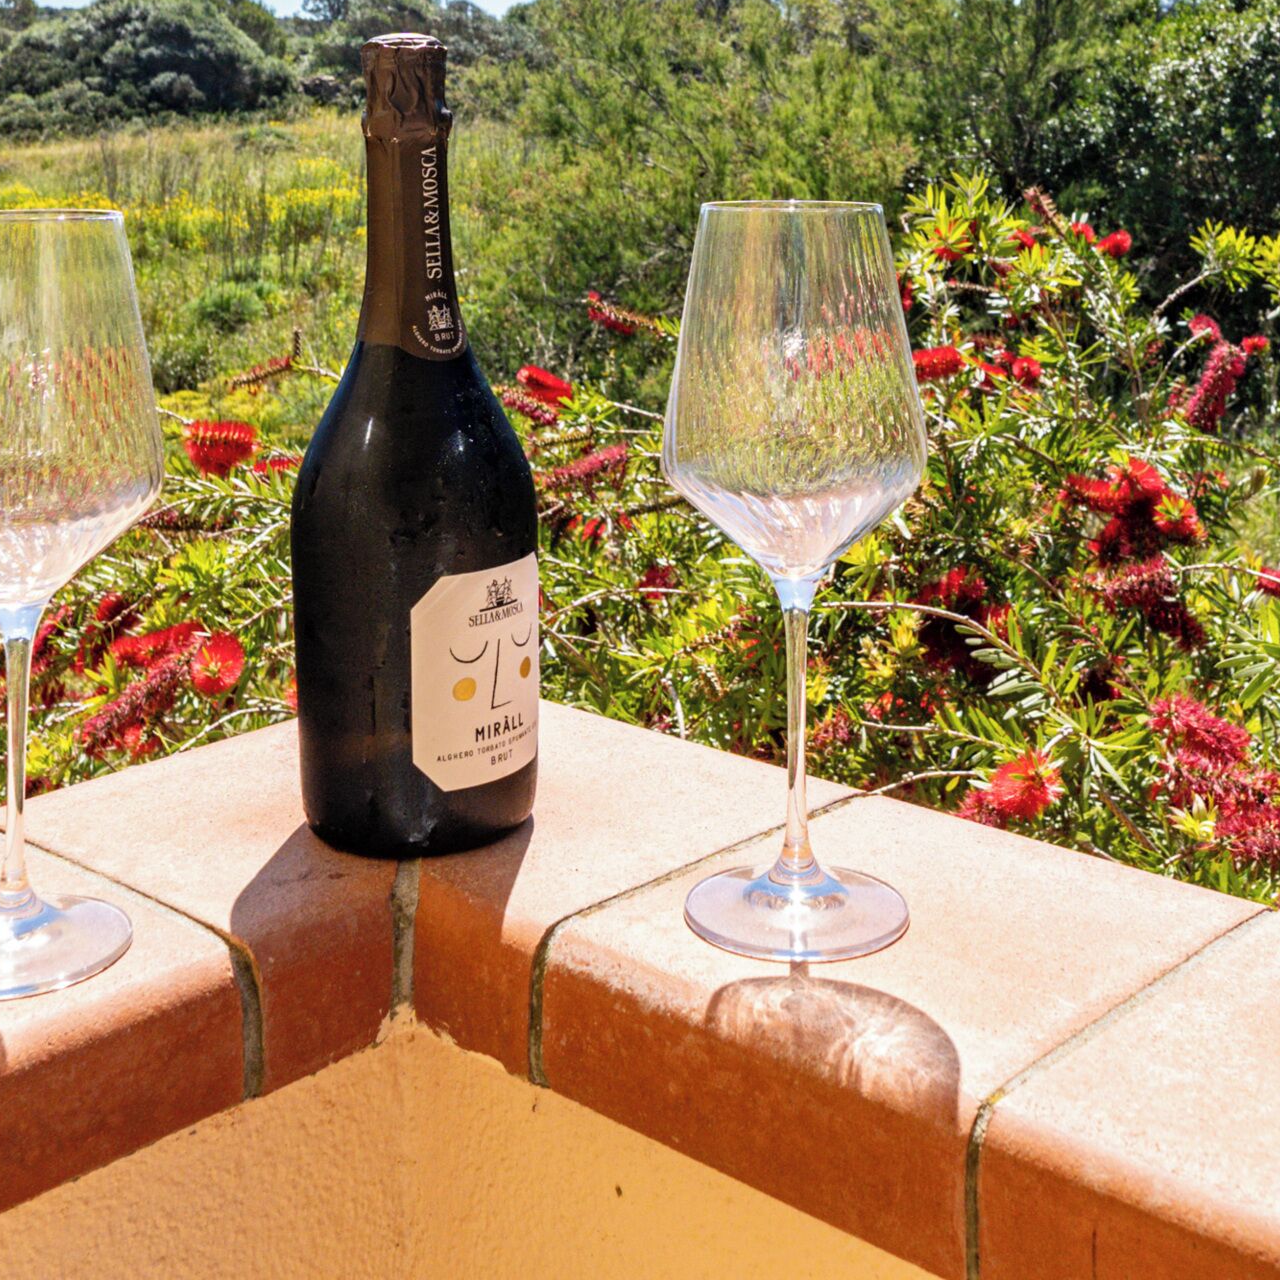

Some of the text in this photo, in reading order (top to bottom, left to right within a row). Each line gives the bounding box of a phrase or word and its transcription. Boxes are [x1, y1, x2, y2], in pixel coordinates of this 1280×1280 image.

[421, 146, 442, 280] SELLA&MOSCA
[434, 331, 455, 342] BRUT
[437, 750, 474, 762] ALGHERO
[477, 740, 506, 755] TORBATO
[490, 749, 513, 766] BRUT
